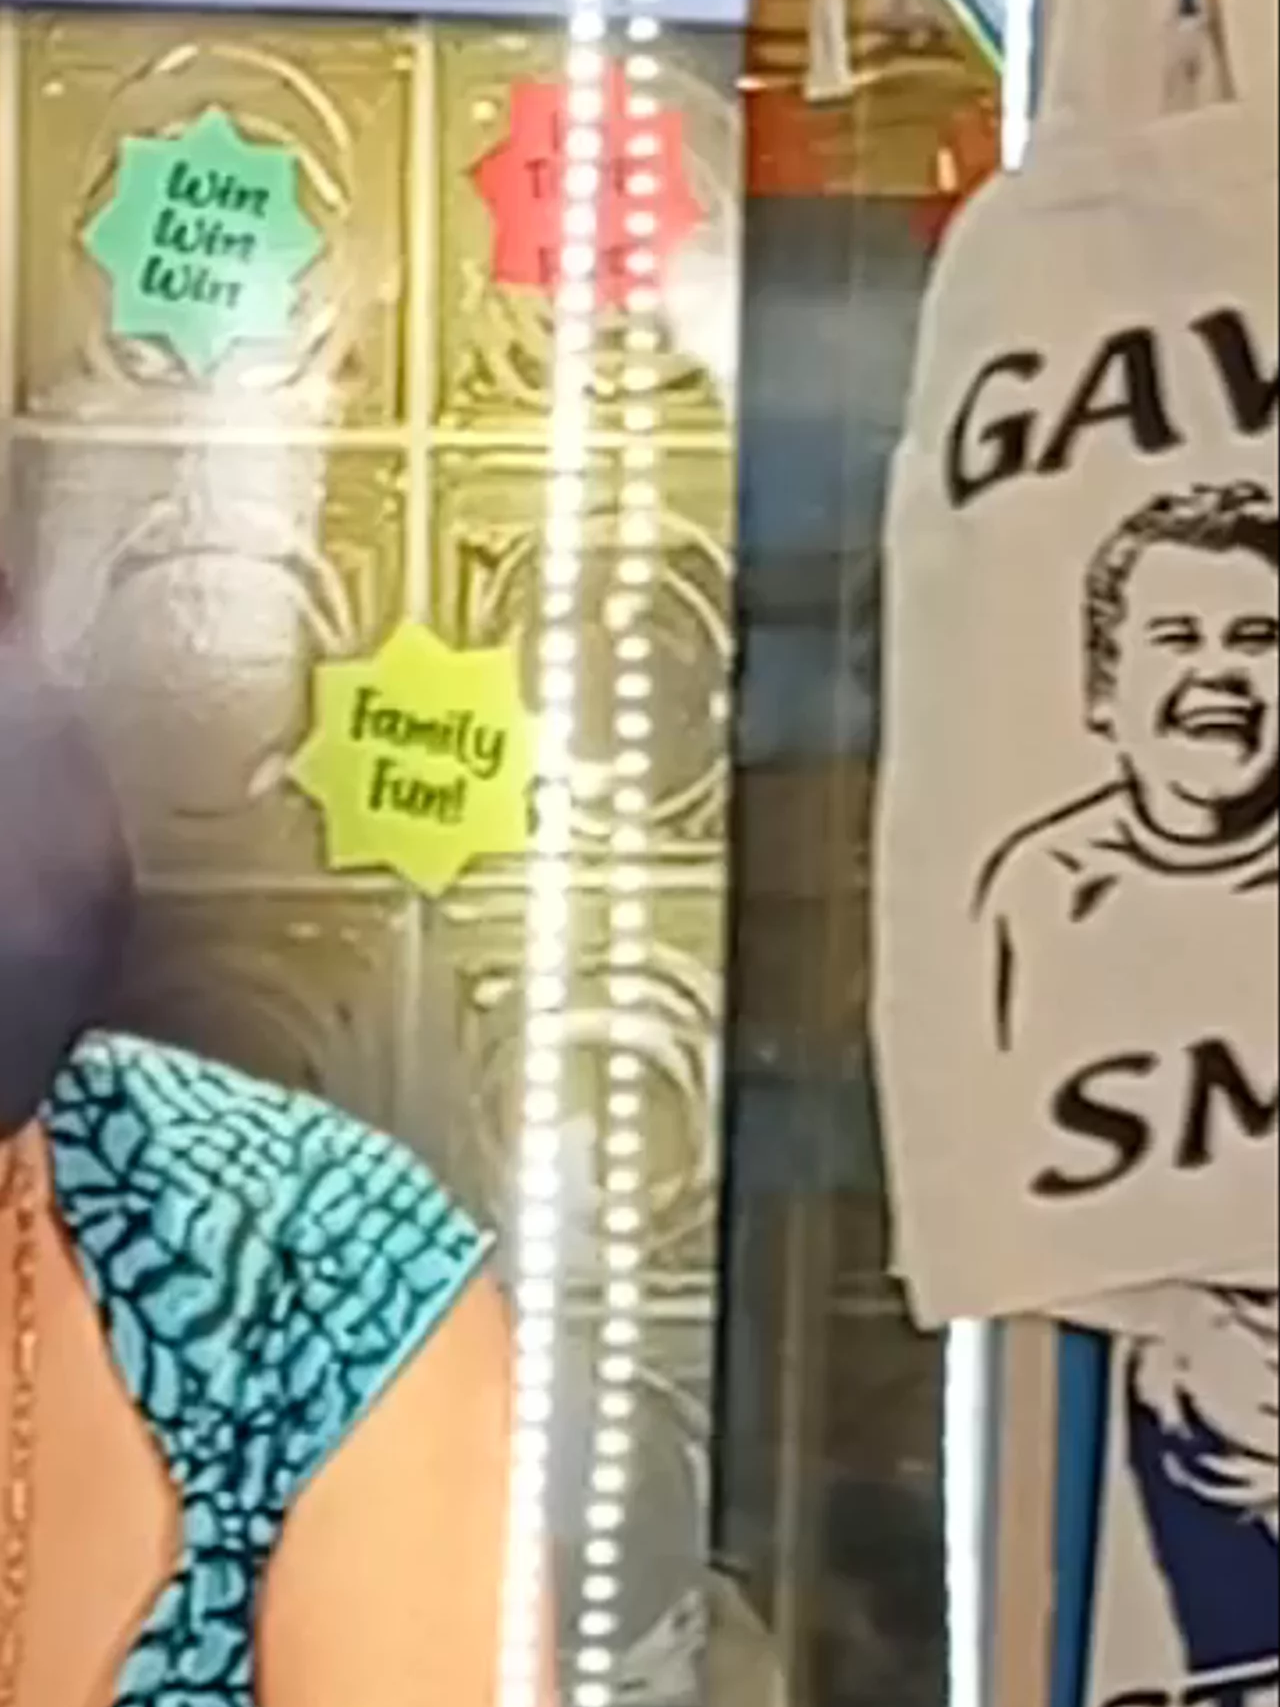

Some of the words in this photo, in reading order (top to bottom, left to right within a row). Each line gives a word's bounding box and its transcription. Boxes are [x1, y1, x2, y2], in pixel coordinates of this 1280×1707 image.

[166, 160, 272, 221] Win
[153, 208, 257, 264] Win
[139, 258, 243, 309] Win
[348, 685, 505, 780] Family
